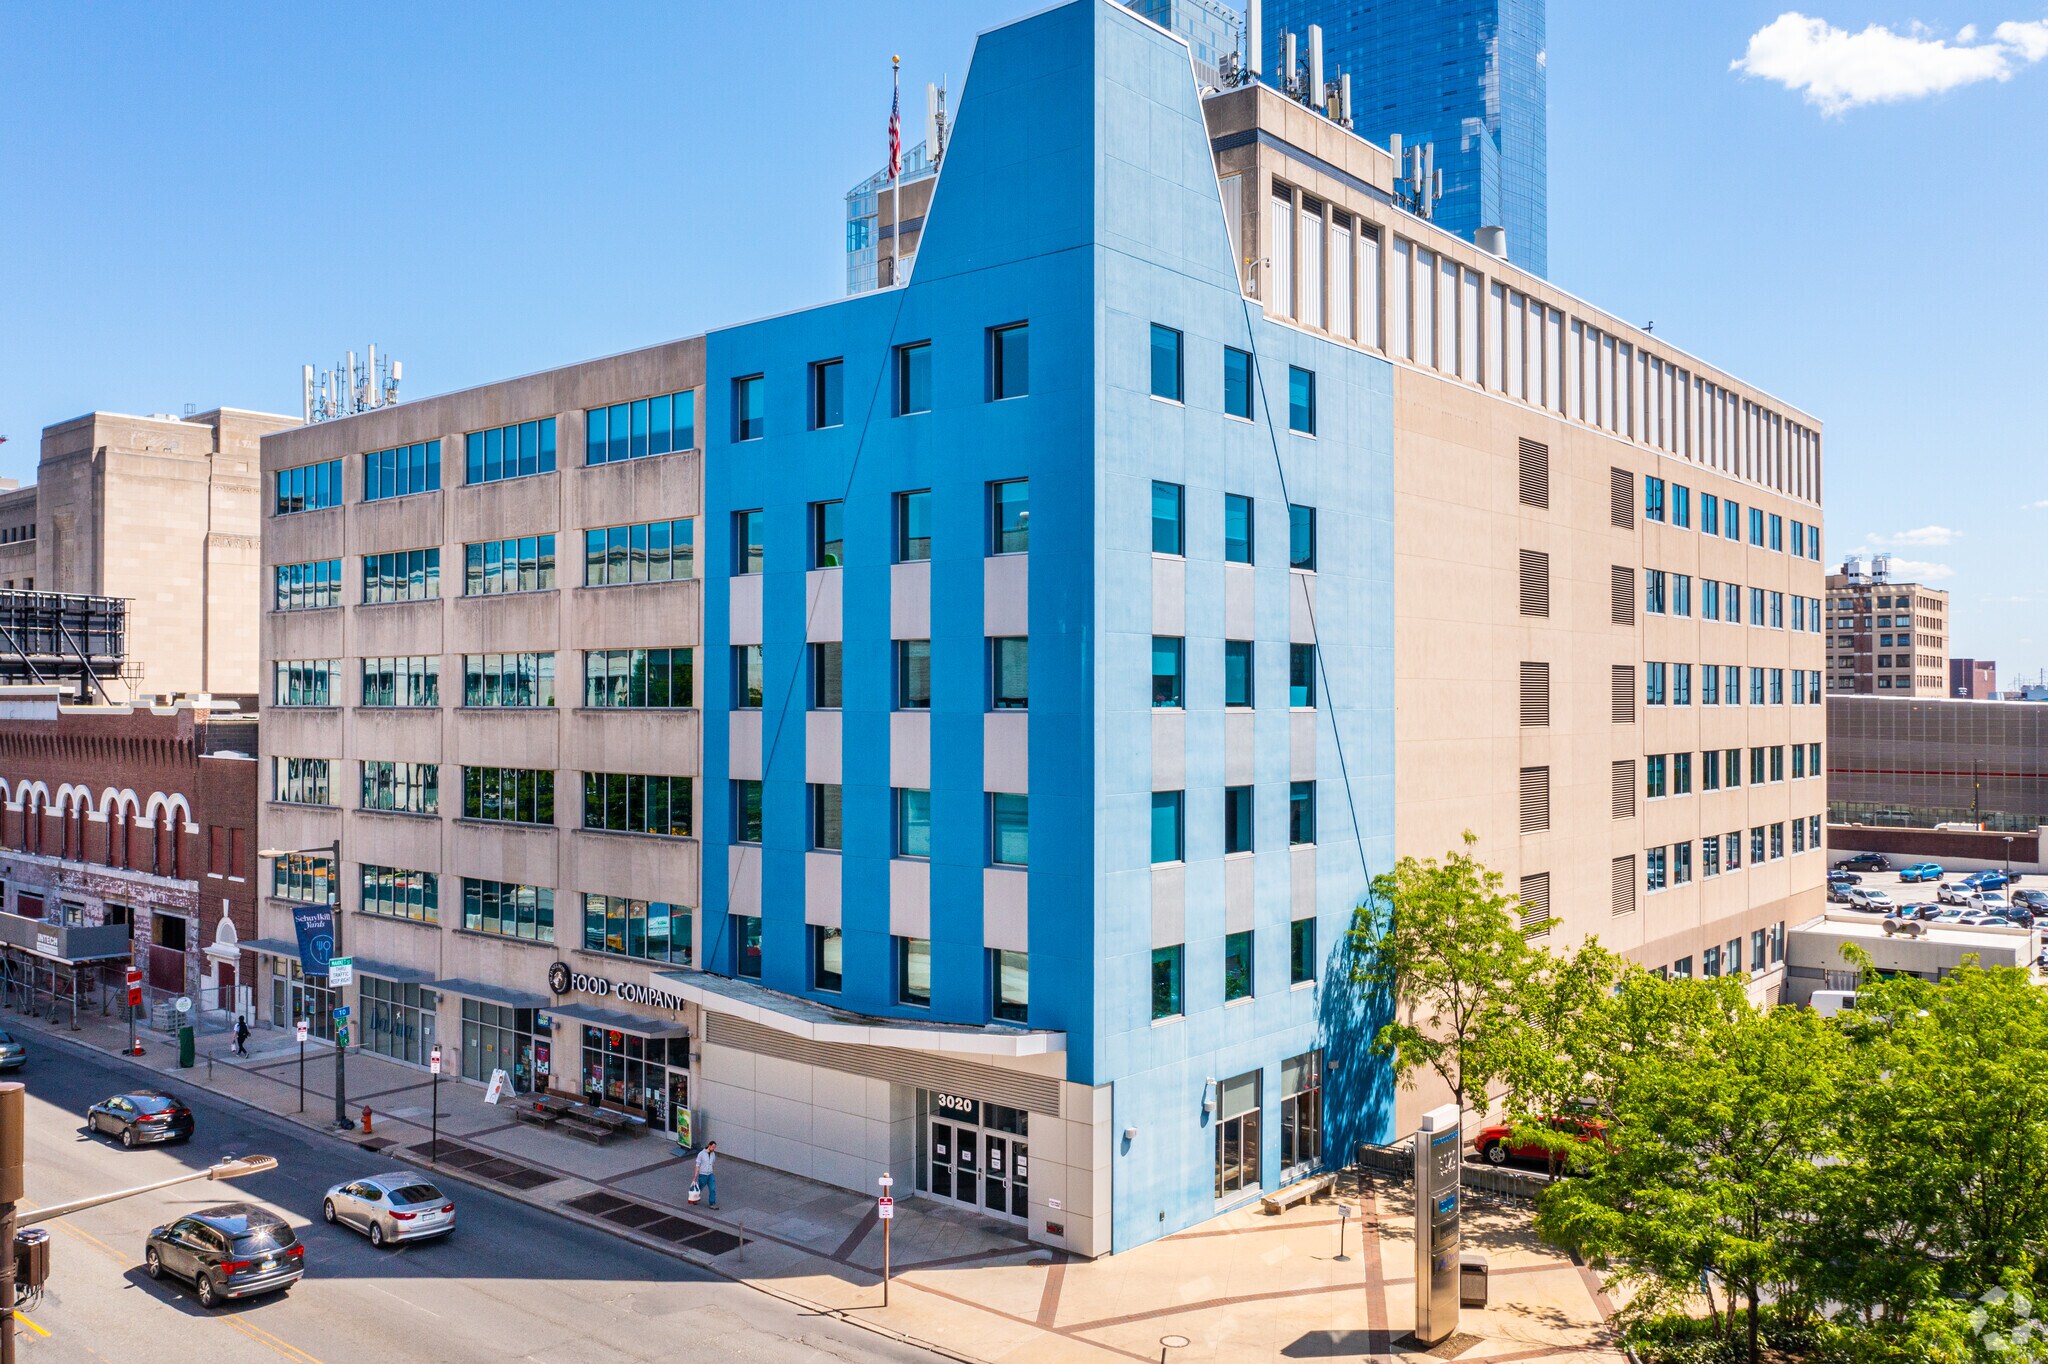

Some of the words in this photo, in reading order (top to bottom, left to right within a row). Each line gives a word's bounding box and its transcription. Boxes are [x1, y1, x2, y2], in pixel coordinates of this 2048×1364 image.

[295, 913, 330, 922] Schuylkill
[304, 920, 325, 930] Yards
[37, 933, 58, 946] INTECH
[571, 974, 608, 996] FOOD
[616, 982, 682, 1011] COMPANY
[938, 1093, 972, 1112] 3020
